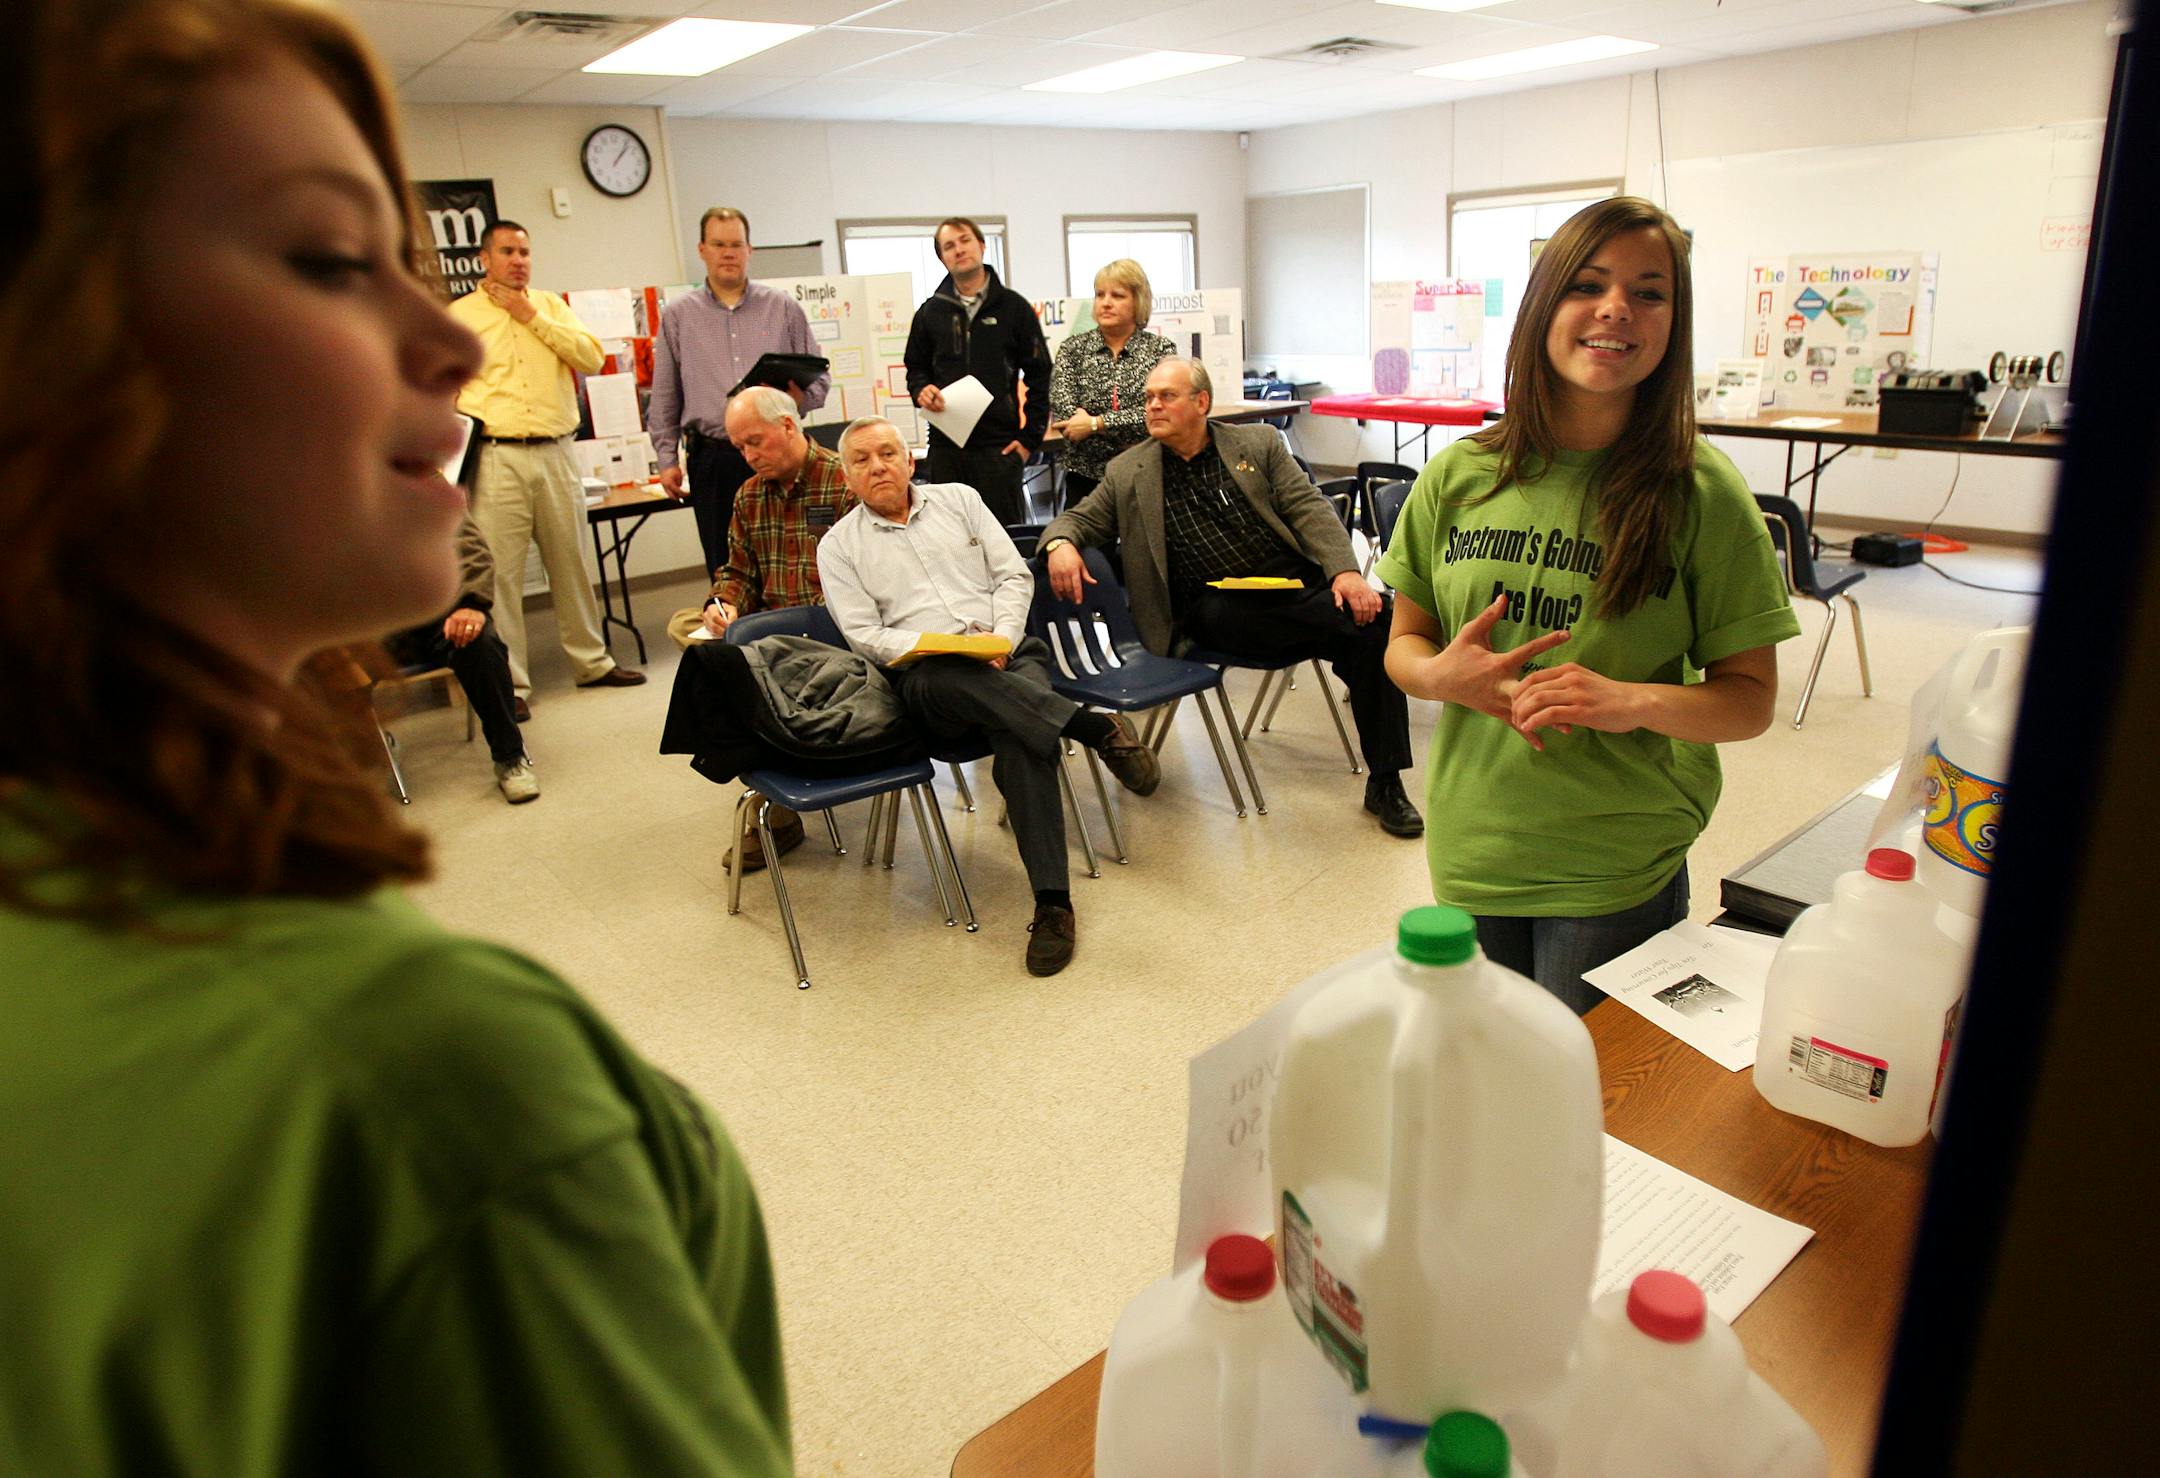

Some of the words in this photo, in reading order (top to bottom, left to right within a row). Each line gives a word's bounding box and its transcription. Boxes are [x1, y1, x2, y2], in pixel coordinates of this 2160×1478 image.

[1754, 267, 1785, 284] The
[1799, 265, 1911, 283] Technology
[796, 283, 837, 304] Simple
[1445, 526, 1543, 566] Spectrum's
[1543, 528, 1604, 582] Going
[1530, 586, 1583, 631] You?
